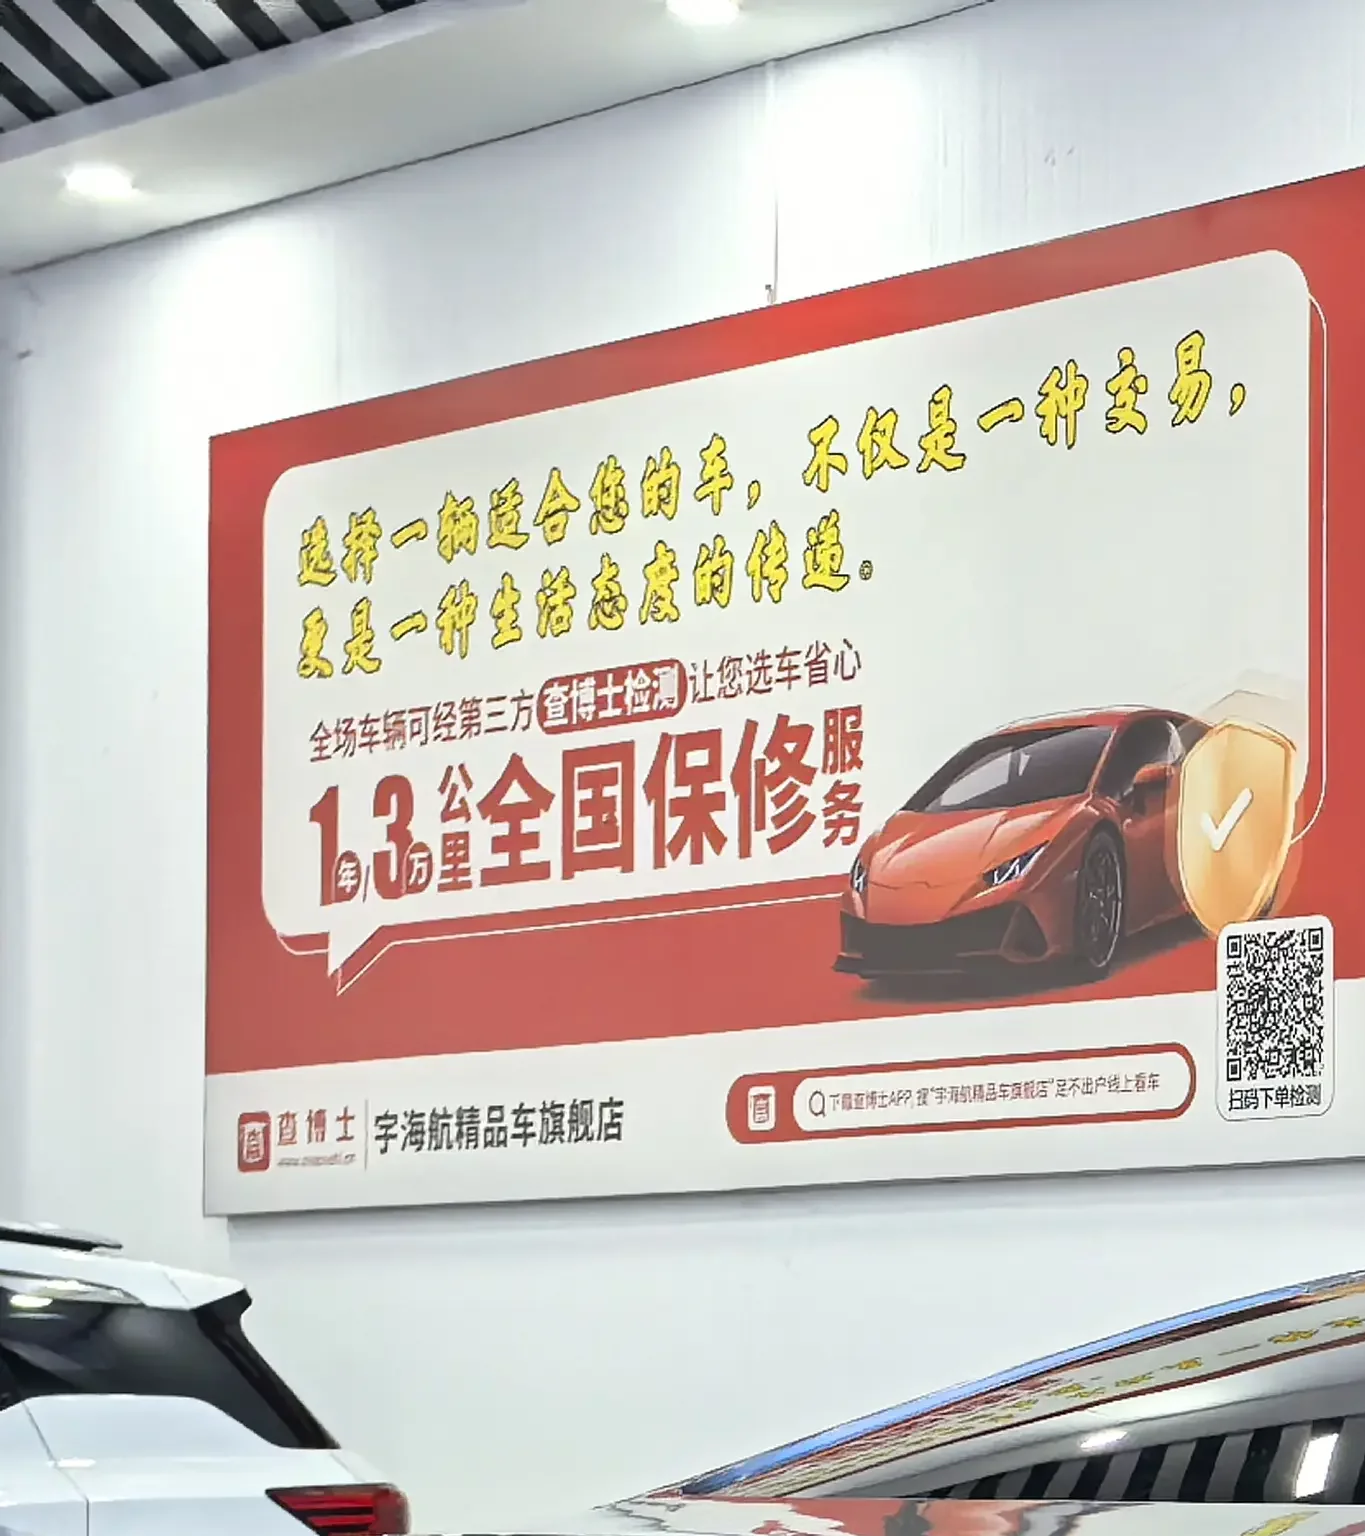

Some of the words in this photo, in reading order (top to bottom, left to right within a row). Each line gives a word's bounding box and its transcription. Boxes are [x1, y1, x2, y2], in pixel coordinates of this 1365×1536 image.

[296, 510, 872, 678] 更是一种生活态度的传递。
[1229, 1084, 1321, 1111] 扫码下单检测
[276, 1106, 355, 1146] 查博士
[373, 1096, 624, 1155] 宇海航精品车旗舰店
